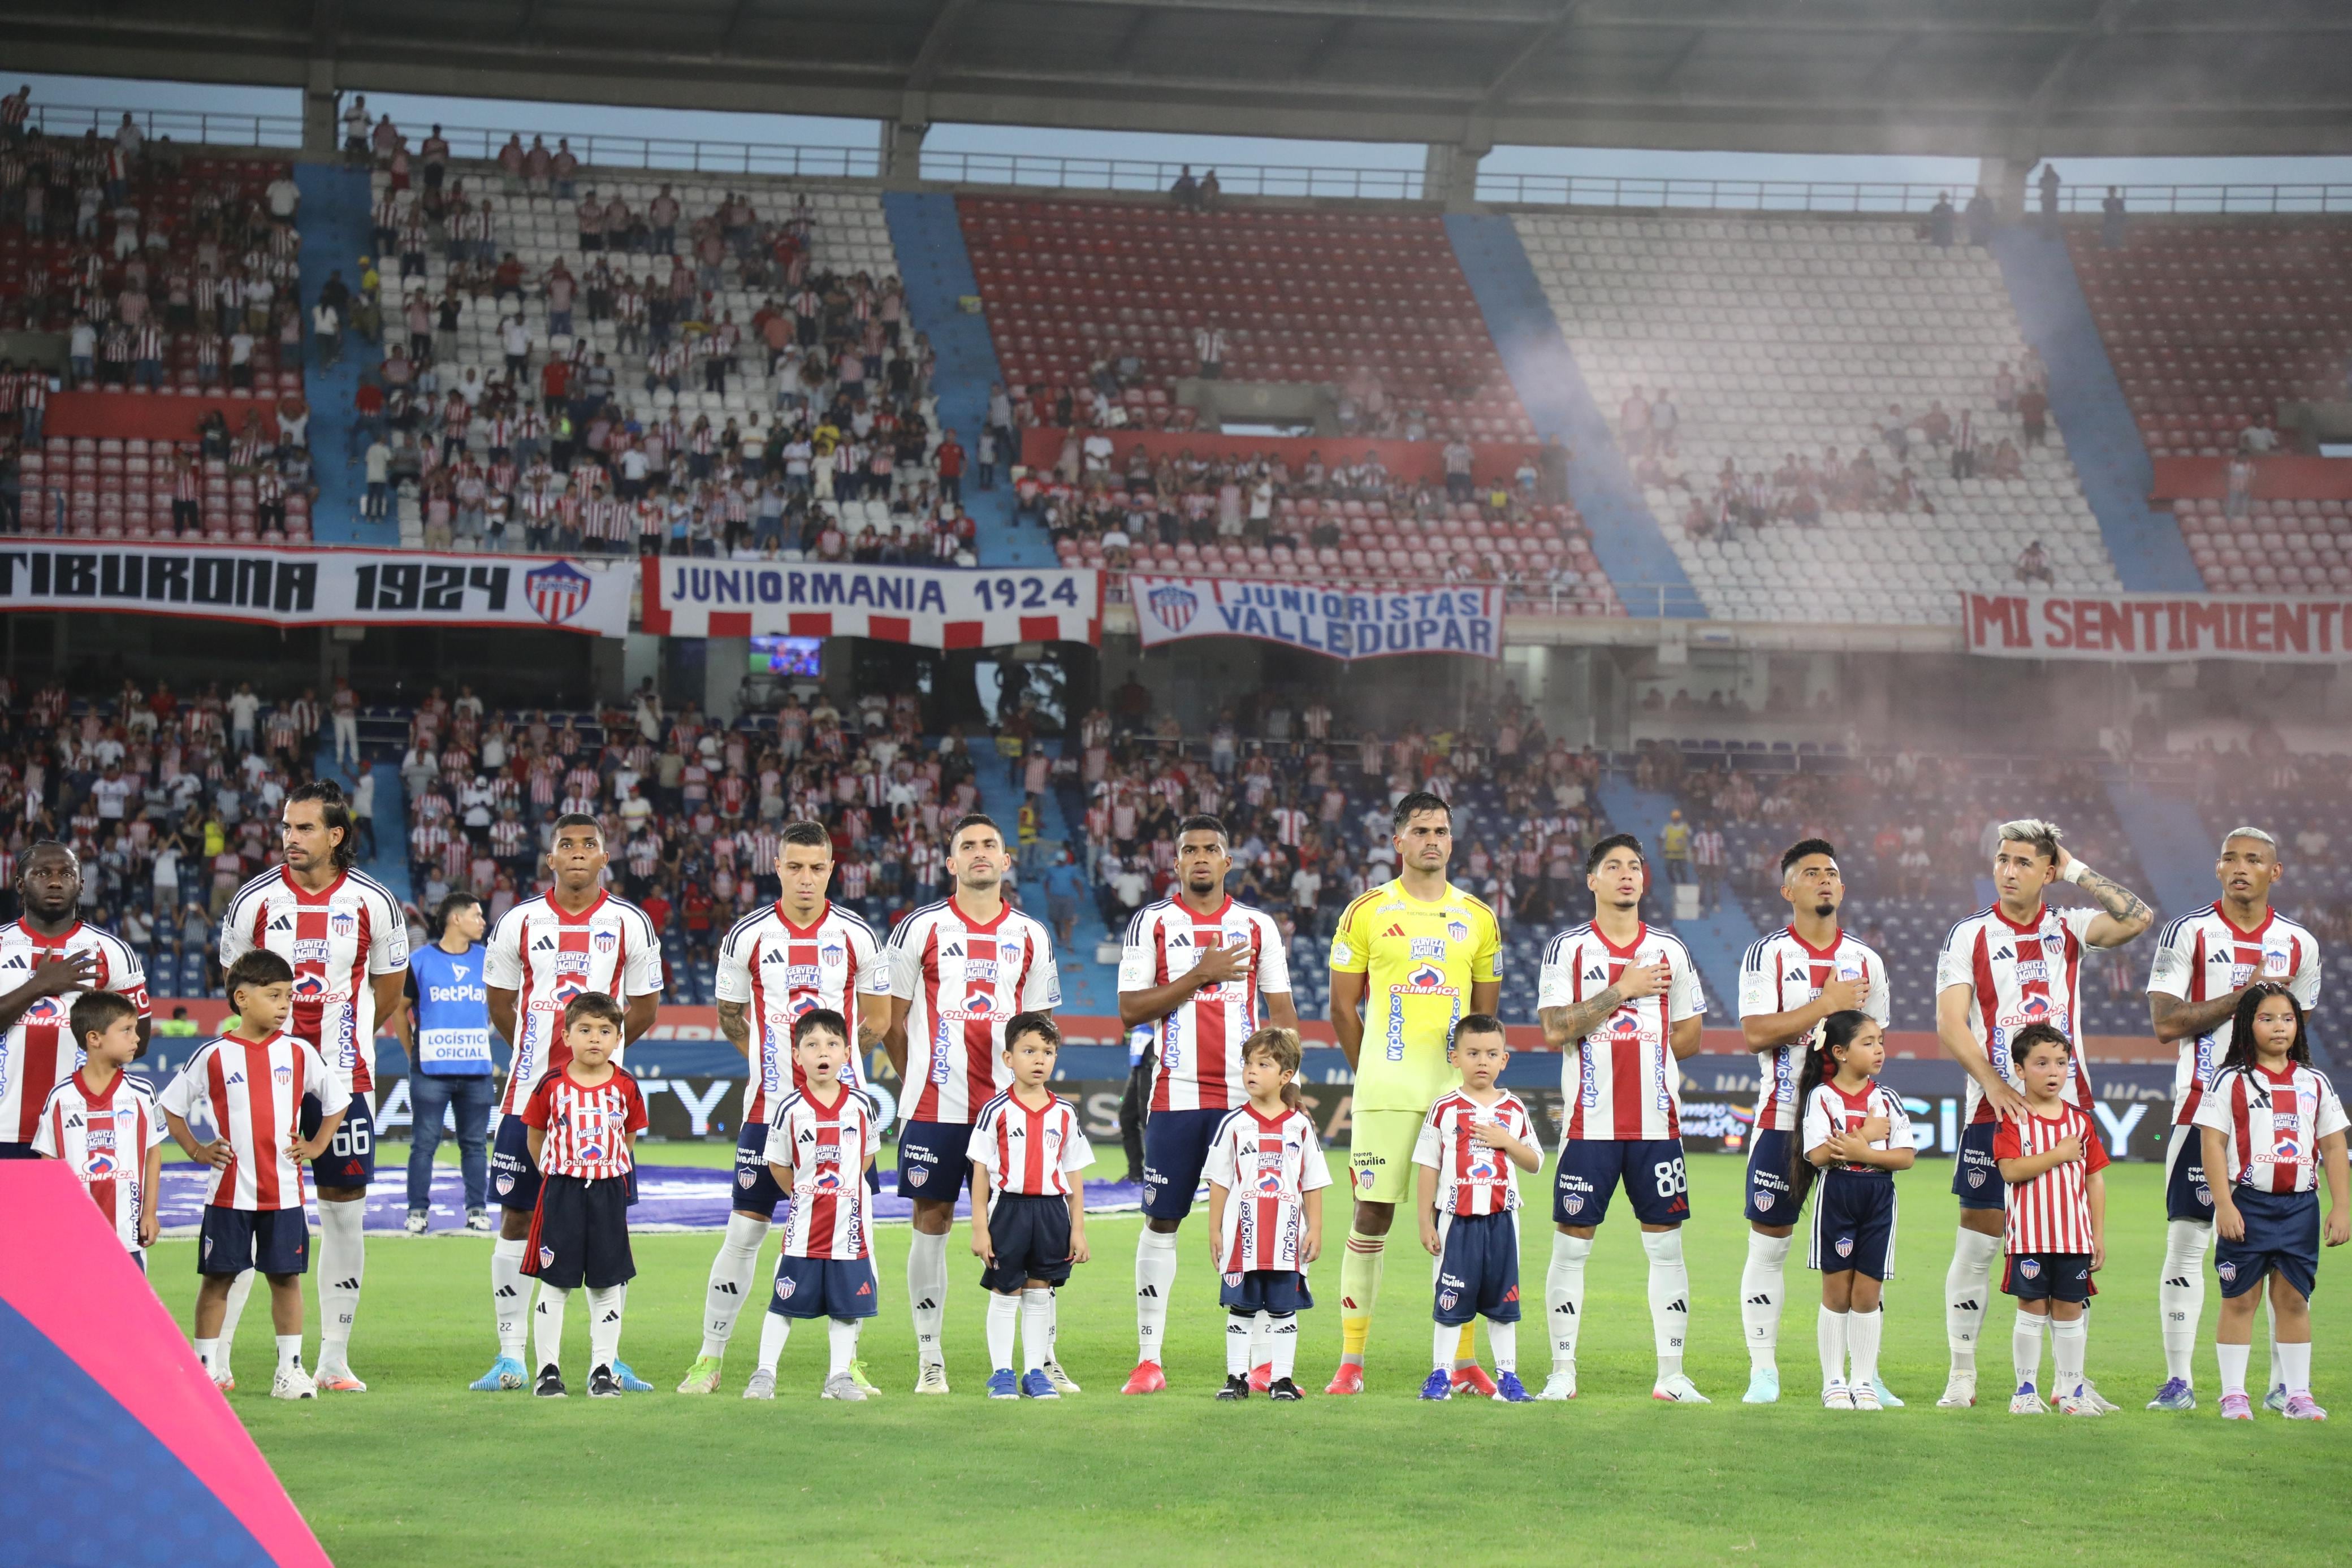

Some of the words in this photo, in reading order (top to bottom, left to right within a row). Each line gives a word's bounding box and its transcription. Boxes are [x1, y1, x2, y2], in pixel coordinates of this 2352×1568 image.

[355, 563, 510, 612] 1924
[671, 568, 946, 614] JUNIORMANIA
[974, 577, 1078, 612] 1924
[1233, 586, 1480, 621] JUNIORISTAS
[1974, 595, 2033, 648] MI
[1217, 605, 1491, 657] VALLEDUPAR
[294, 940, 329, 950] GERVEZA
[1412, 938, 1445, 948] GERVEZA
[295, 947, 328, 959] AGUILA
[556, 952, 590, 962] GERVEZA
[1412, 946, 1445, 958] AGUILA
[557, 960, 590, 972] AGUILA
[786, 966, 820, 976] GERVEZA
[965, 960, 998, 971] GERVEZA
[2015, 961, 2046, 972] GERVEZA
[788, 973, 820, 985] AGUILA
[966, 968, 998, 980] AGUILA
[2017, 969, 2047, 982] AGUILA
[1389, 984, 1459, 995] OLIMPICA
[290, 991, 347, 1003] IMPICA
[942, 1010, 1012, 1022] OLIMPICA
[1387, 994, 1404, 1061] Wplay.co
[1588, 1032, 1658, 1043] OLIMPICA
[515, 1012, 537, 1080] Wplay.co
[932, 1019, 951, 1084] Wplay.co
[436, 1048, 483, 1058] OFICIAL
[1992, 1026, 2009, 1082] play.co
[1654, 1045, 1670, 1110] Wplay.co
[2275, 1120, 2298, 1128] AGUILA
[87, 1130, 114, 1140] GERVEZA
[332, 1118, 369, 1156] 66
[576, 1127, 603, 1139] AGUILA
[89, 1137, 114, 1146] AGUILA
[906, 1143, 929, 1153] expreso
[494, 1151, 516, 1162] expreso
[736, 1153, 768, 1166] brasilia
[816, 1152, 840, 1160] AGUILA
[904, 1149, 938, 1164] brasilia
[1354, 1156, 1386, 1166] brasilia
[2254, 1155, 2312, 1166] OLIMPICA
[491, 1157, 526, 1173] brasilia
[564, 1158, 614, 1168] OLIMPICA
[1260, 1159, 1282, 1168] AGUILA
[78, 1171, 135, 1183] LIMPICA
[1654, 1157, 1687, 1198] 88
[1755, 1169, 1779, 1180] expreso
[1454, 1177, 1509, 1186] OLIMPICA
[1559, 1179, 1593, 1192] brasilia
[1754, 1174, 1789, 1192] brasilia
[798, 1184, 856, 1197] OLIMPICA
[1242, 1190, 1296, 1203] OLIMPICA
[848, 1198, 862, 1254] Wplay.co
[1240, 1202, 1253, 1258] Wplay.co
[1283, 1205, 1298, 1261] Wplay.co
[2168, 1312, 2185, 1321] 98
[500, 1323, 512, 1331] 22
[714, 1321, 727, 1330] 17
[1141, 1326, 1152, 1335] 26
[1265, 1324, 1271, 1333] 2
[1756, 1327, 1763, 1336] 3
[1559, 1341, 1570, 1350] 88
[1670, 1338, 1682, 1346] 88
